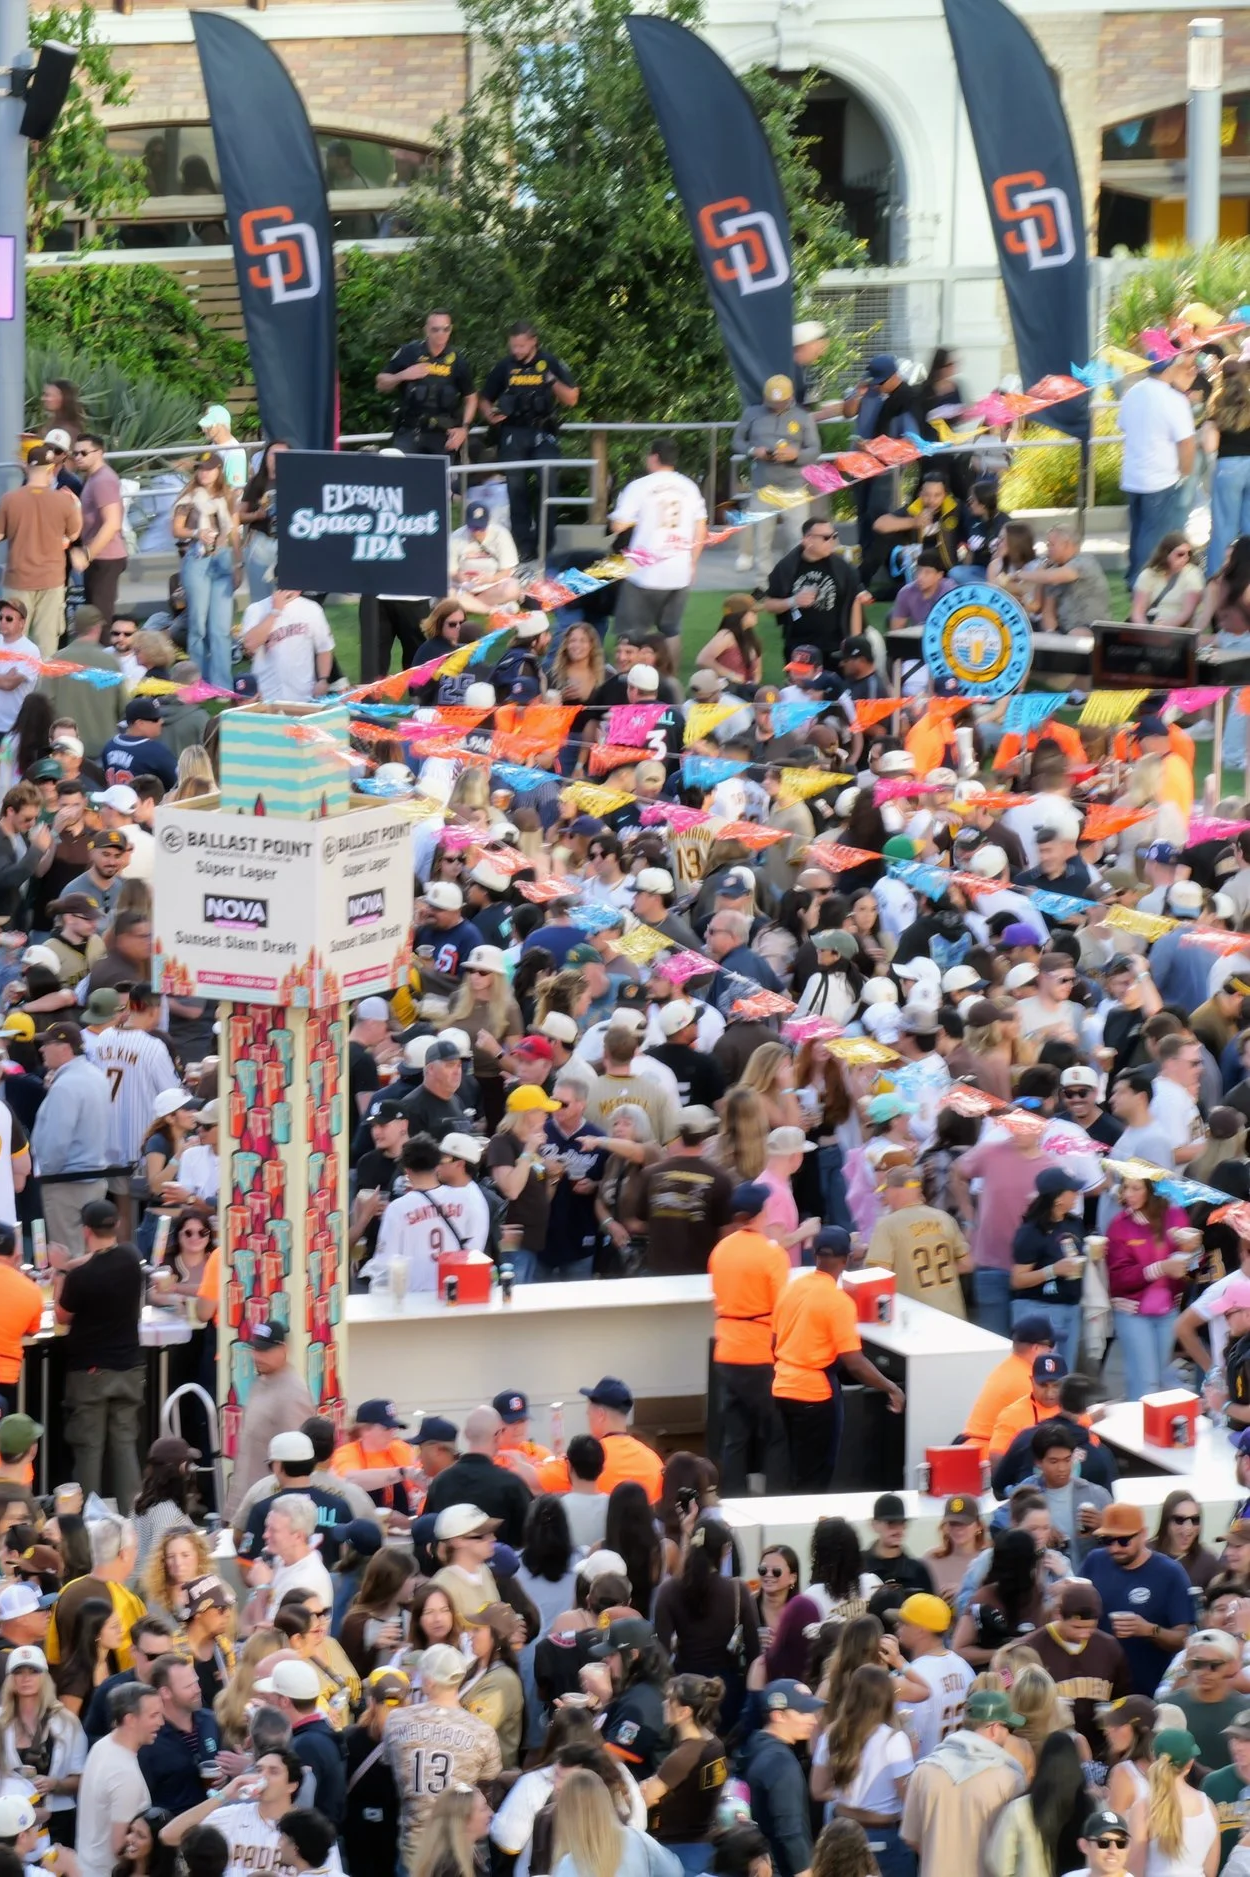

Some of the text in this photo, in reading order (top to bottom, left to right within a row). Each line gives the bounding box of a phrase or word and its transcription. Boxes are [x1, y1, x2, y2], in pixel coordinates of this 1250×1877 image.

[992, 171, 1076, 271] SD
[240, 206, 321, 305] SD
[698, 196, 790, 297] SD
[321, 483, 404, 513] ELYSIAN
[288, 507, 439, 539] Space Dust
[352, 534, 407, 561] IPA
[928, 588, 1028, 639] PIZZA PORT
[645, 728, 669, 763] 3
[188, 830, 257, 855] BALLAST
[262, 839, 313, 858] POINT
[338, 828, 380, 853] BALLAST
[381, 821, 411, 842] POINT
[239, 863, 278, 881] Lager
[368, 856, 391, 872] Lager
[676, 846, 703, 880] 13
[205, 897, 266, 922] NOVA
[348, 892, 384, 917] NOVA
[175, 930, 297, 955] Sunset Slam Draft
[329, 924, 402, 953] Sunset Slam Draft
[117, 1046, 138, 1066] KIM
[106, 1067, 124, 1105] 7
[429, 1227, 444, 1262] 9
[913, 1242, 954, 1289] 22
[404, 1723, 477, 1750] MACHADO
[412, 1749, 453, 1795] 13
